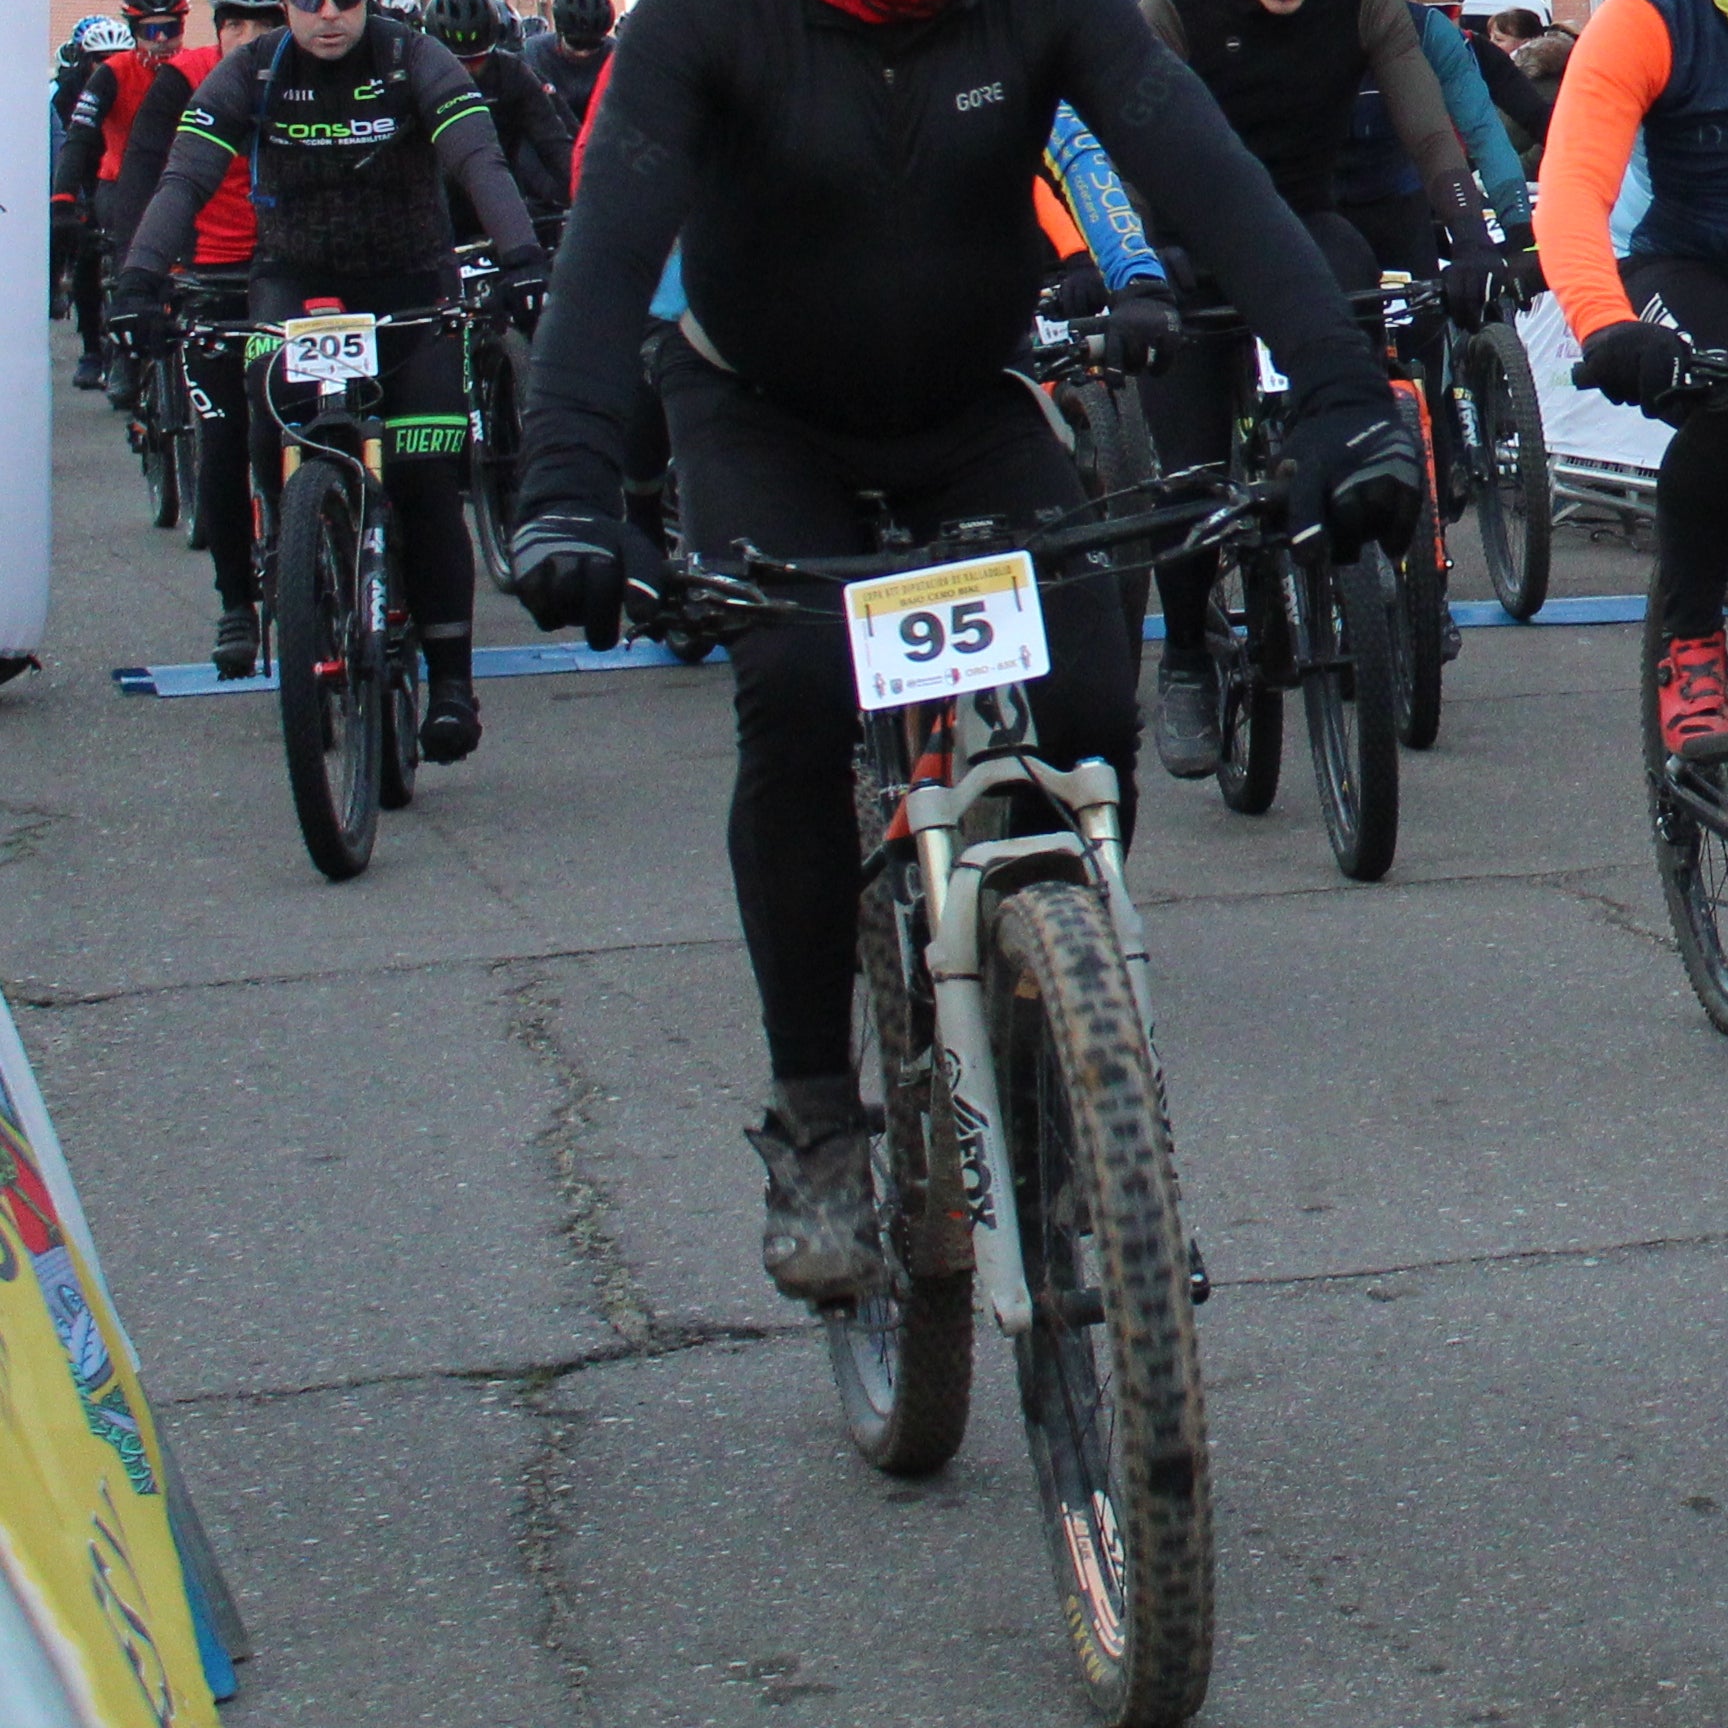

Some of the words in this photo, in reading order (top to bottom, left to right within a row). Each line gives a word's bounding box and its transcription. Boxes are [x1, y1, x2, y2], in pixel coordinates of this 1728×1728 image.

[956, 82, 1005, 112] GORE
[299, 333, 367, 361] 205
[899, 599, 994, 663] 95
